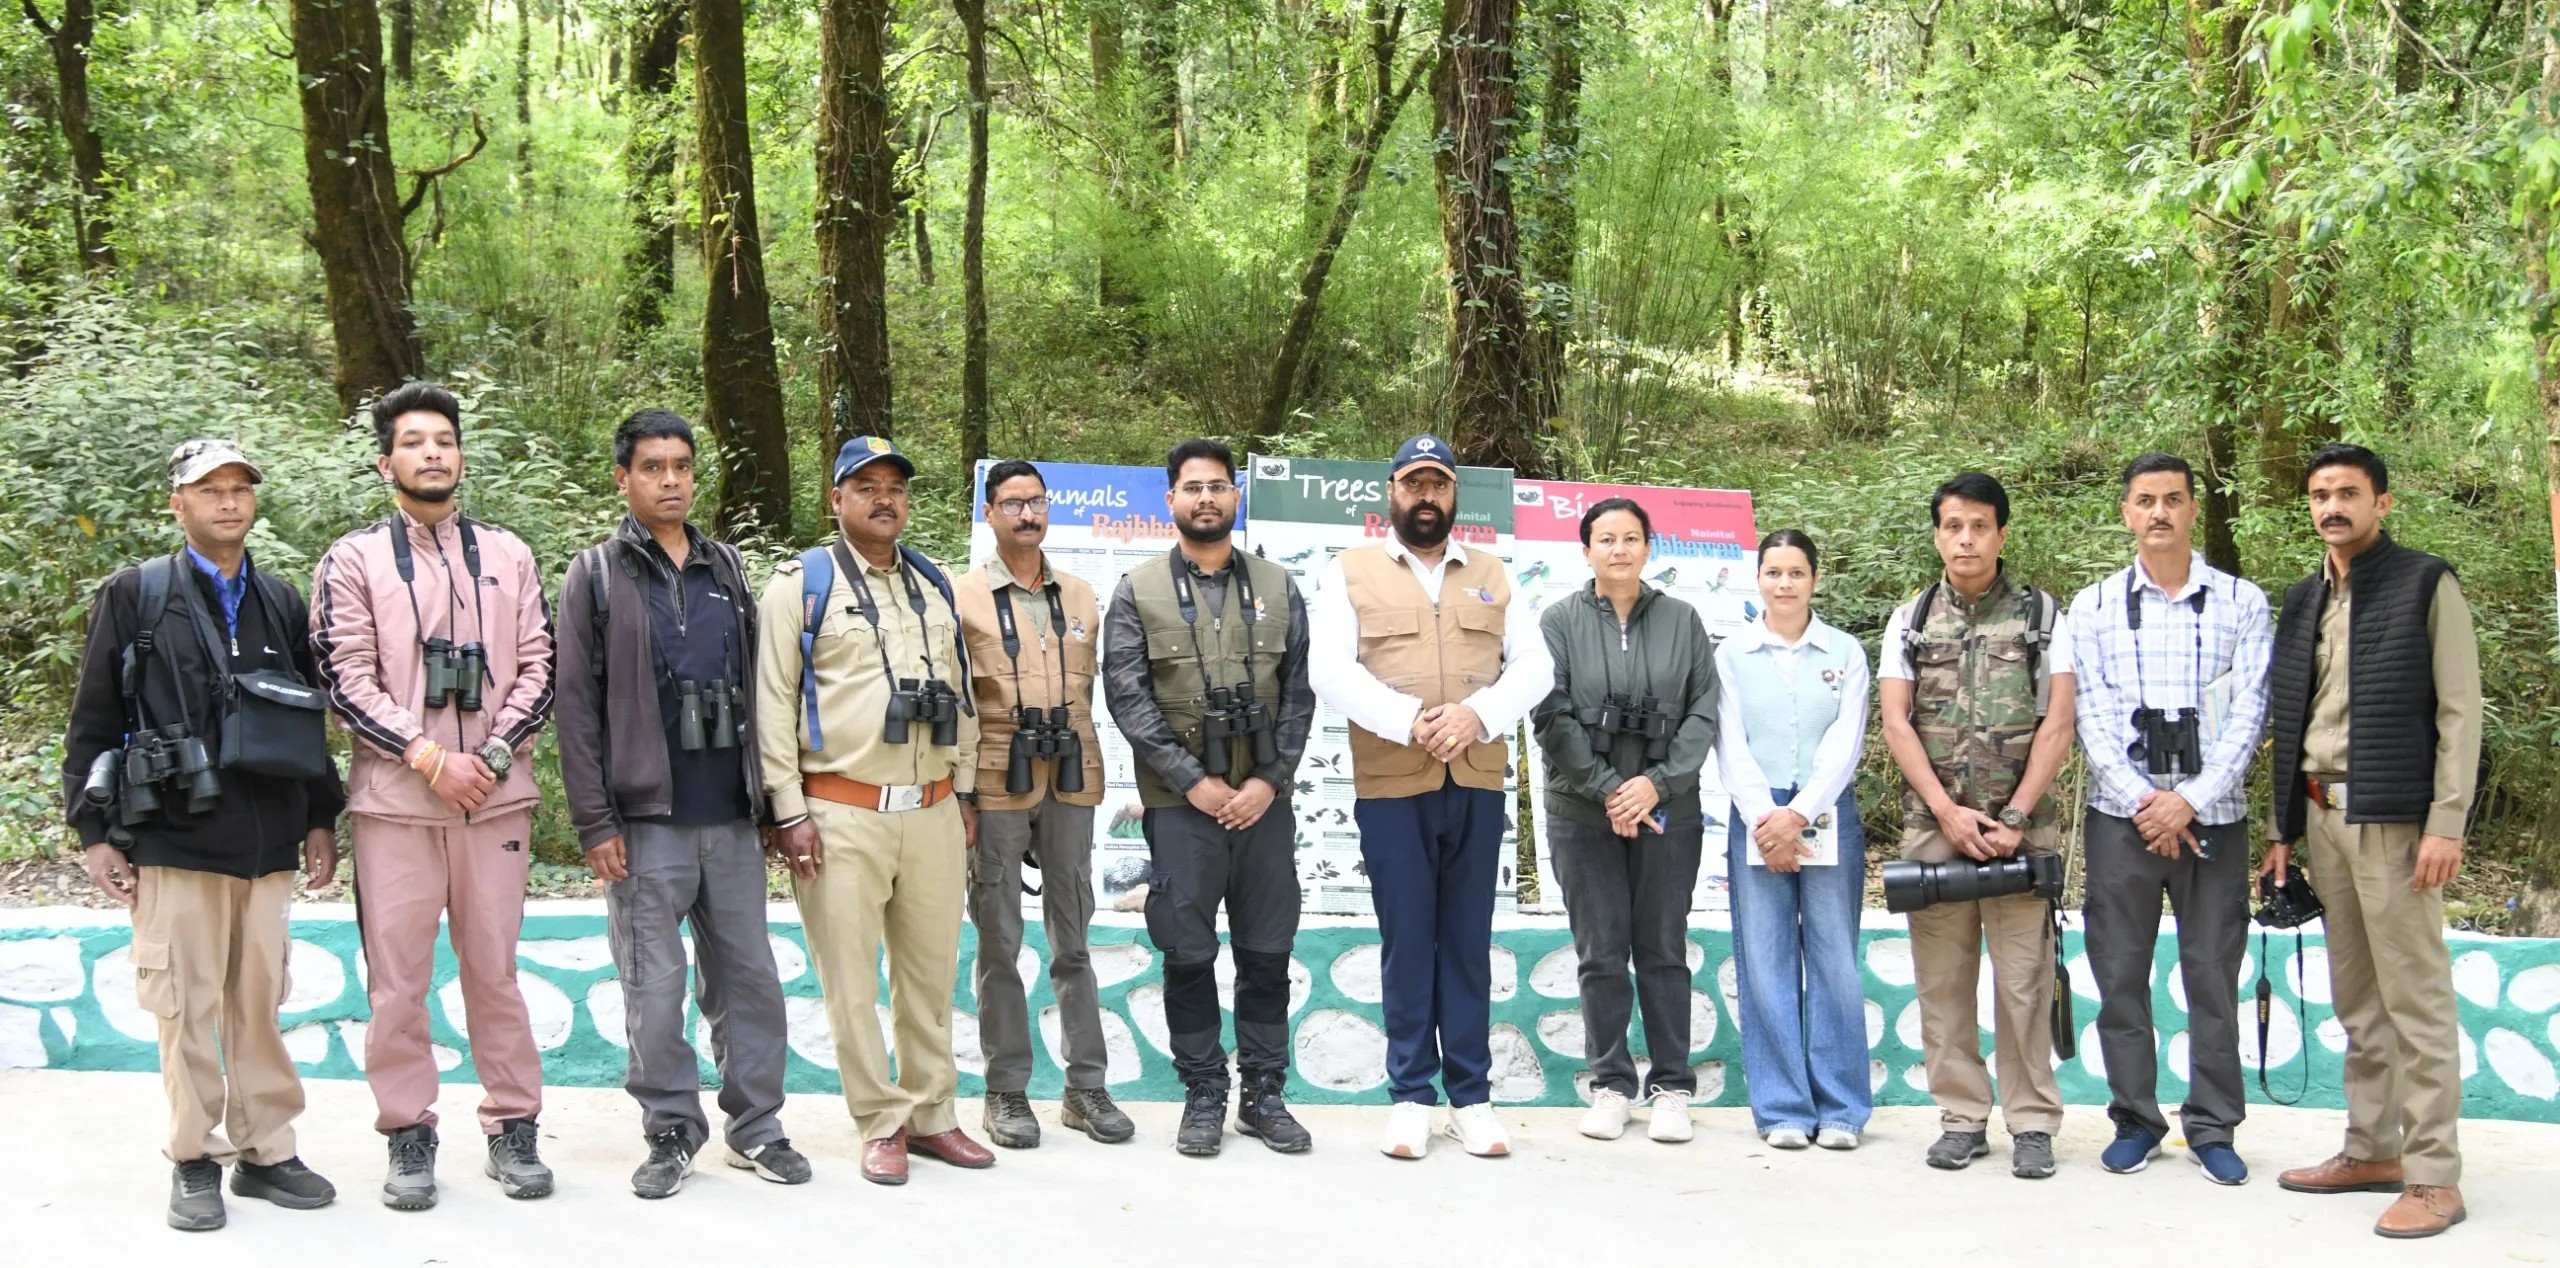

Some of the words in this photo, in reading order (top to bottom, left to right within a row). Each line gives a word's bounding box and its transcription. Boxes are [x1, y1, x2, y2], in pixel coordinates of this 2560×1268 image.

[1046, 484, 1128, 507] mmals
[1294, 474, 1381, 502] Trees
[1073, 506, 1086, 519] of
[1345, 504, 1358, 518] of
[1091, 512, 1179, 545] Rajbha
[1690, 528, 1736, 540] Nainital
[1648, 532, 1744, 561] jbhawan
